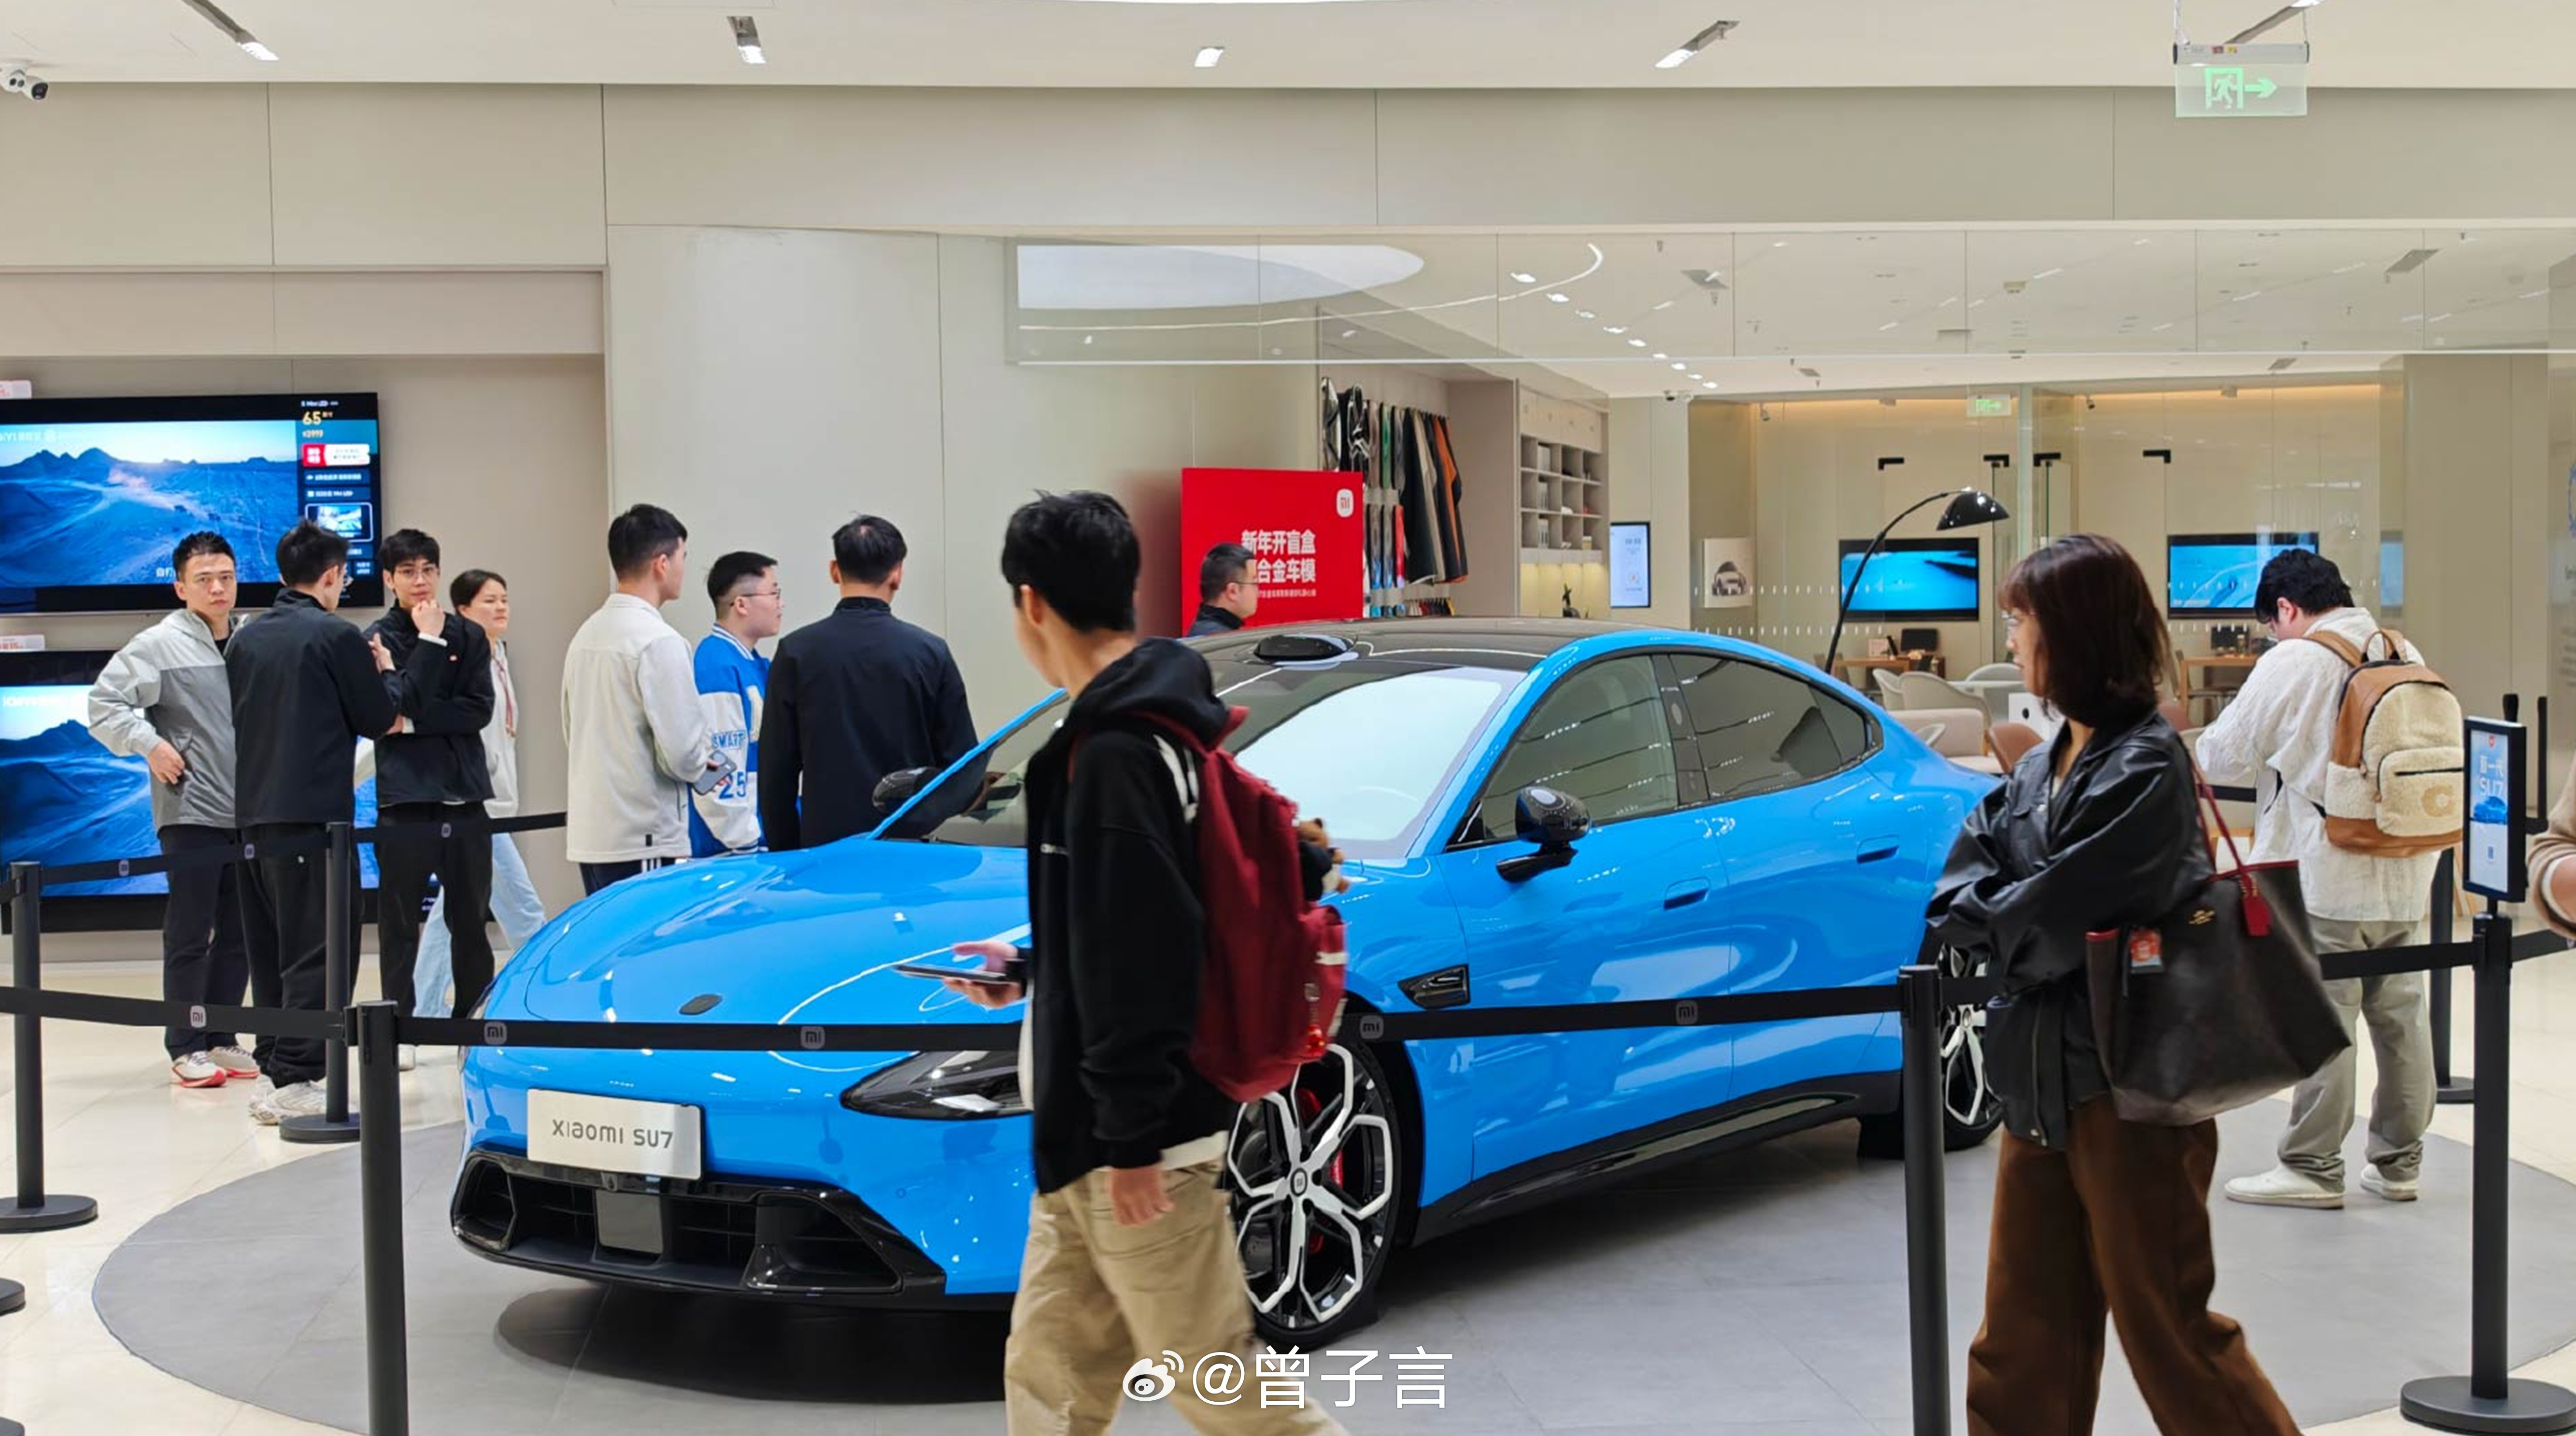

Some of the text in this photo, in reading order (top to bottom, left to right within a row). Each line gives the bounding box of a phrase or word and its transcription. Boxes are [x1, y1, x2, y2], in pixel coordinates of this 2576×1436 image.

[302, 411, 322, 425] 65
[1241, 529, 1316, 555] 新年开盲盒
[1254, 558, 1316, 583] 合金车模
[718, 771, 747, 800] 25
[2479, 777, 2505, 797] SU7
[1679, 1006, 1694, 1018] mi
[487, 1026, 503, 1038] mi
[1363, 1023, 1380, 1032] mi
[805, 1031, 821, 1043] mi
[633, 1128, 673, 1149] SU7
